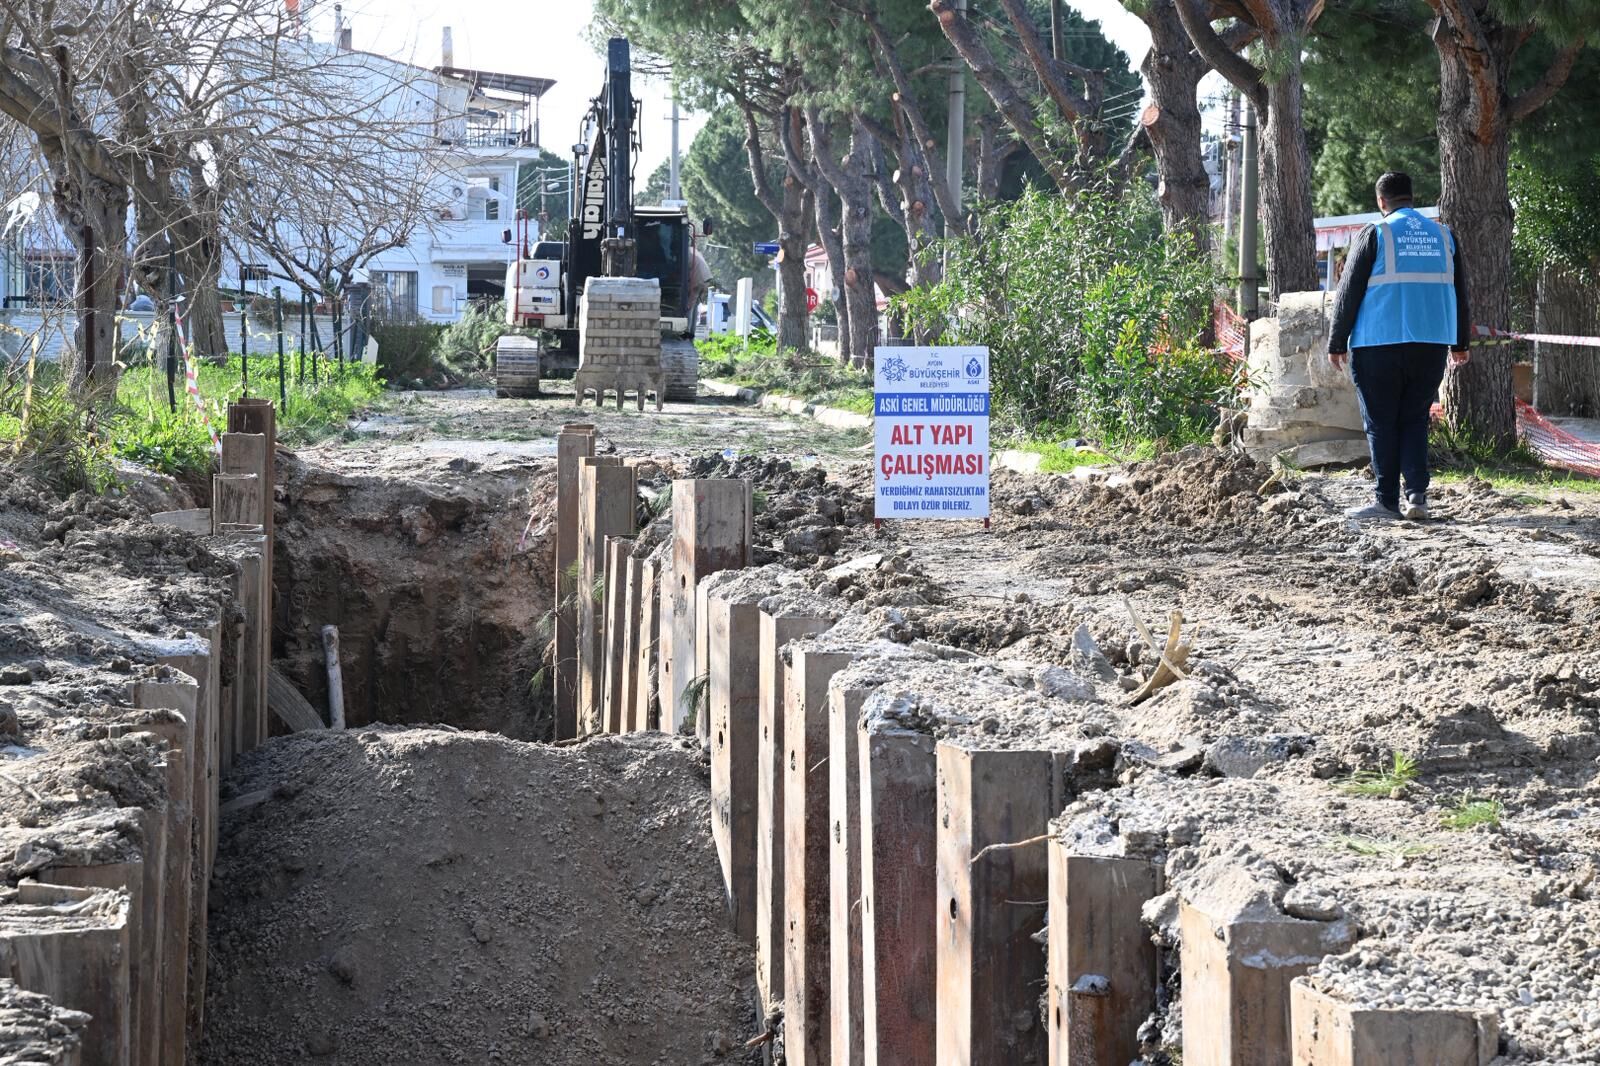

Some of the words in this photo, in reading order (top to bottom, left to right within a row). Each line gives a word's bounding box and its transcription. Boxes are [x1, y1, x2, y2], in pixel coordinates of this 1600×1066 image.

[1397, 236, 1438, 244] BÜYÜKŞEHİR
[909, 368, 960, 380] BÜYÜKŞEHİR
[880, 395, 899, 412] ASKİ
[902, 398, 928, 412] GENEL
[931, 394, 985, 412] MÜDÜRLÜĞÜ
[891, 425, 924, 445] ALT
[930, 425, 972, 445] YAPI
[881, 454, 983, 480] ÇALIŞMASI
[880, 485, 922, 496] VERDİĞİMİZ
[924, 487, 985, 496] RAHATSIZLIKTAN
[894, 501, 919, 510] DOLAYI
[921, 500, 940, 510] ÖZÜR
[942, 499, 972, 510] DİLERİZ.
